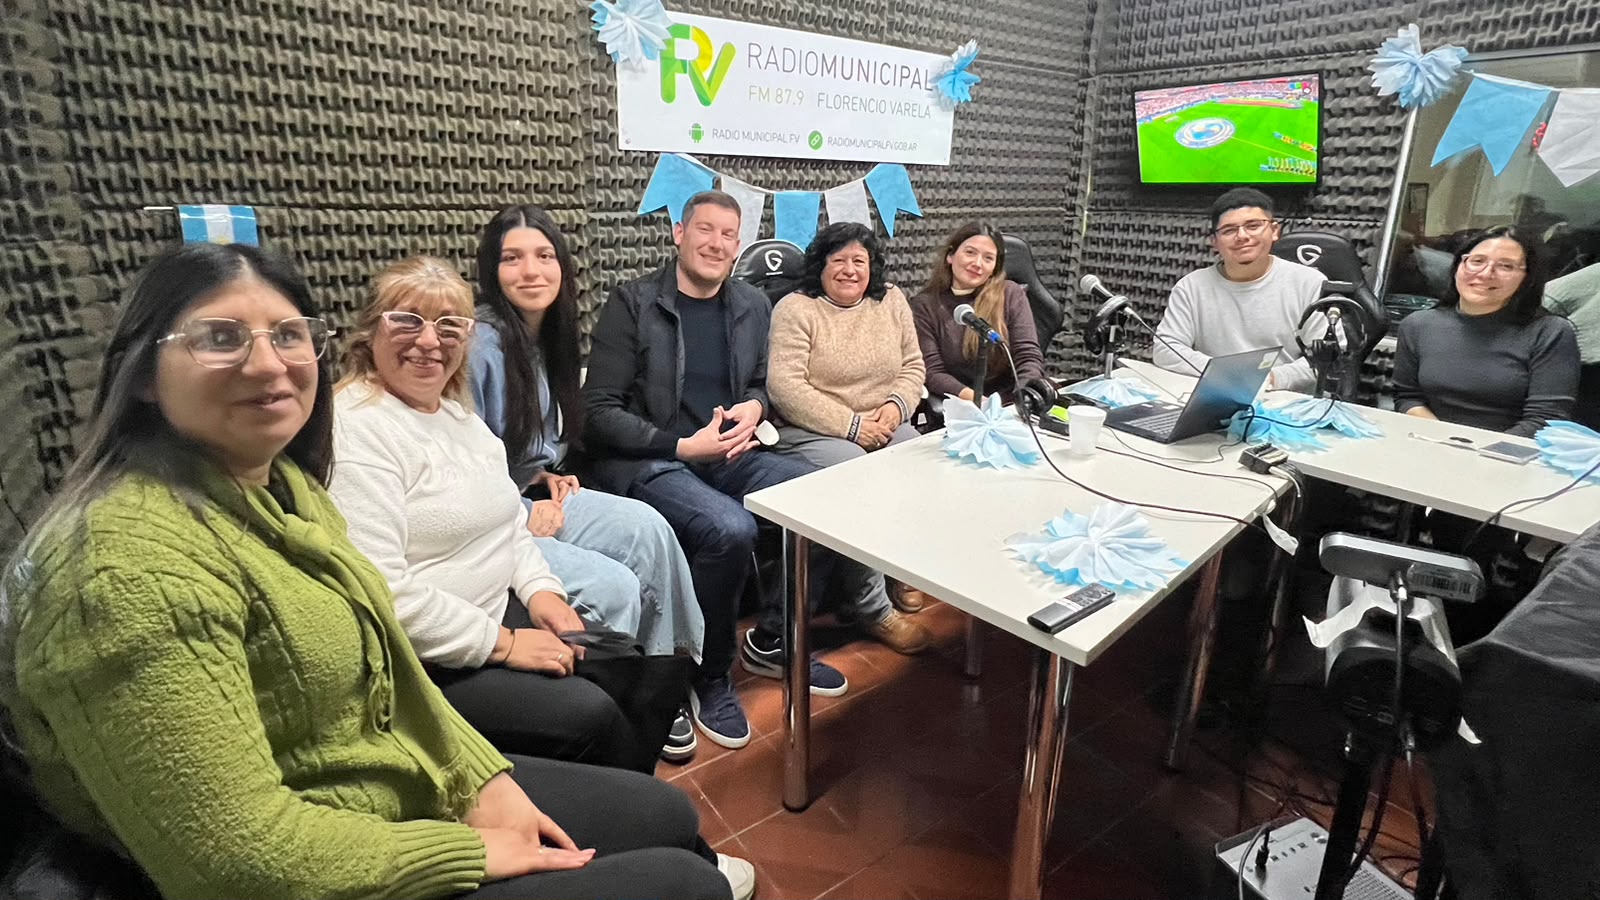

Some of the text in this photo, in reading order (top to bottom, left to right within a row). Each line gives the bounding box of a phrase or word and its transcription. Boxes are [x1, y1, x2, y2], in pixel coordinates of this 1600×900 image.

[748, 42, 933, 91] RADIOMUNICIPAL
[748, 85, 804, 106] FM 87.9
[817, 92, 931, 119] FLORENCIO VARELA
[712, 128, 740, 141] RADIO
